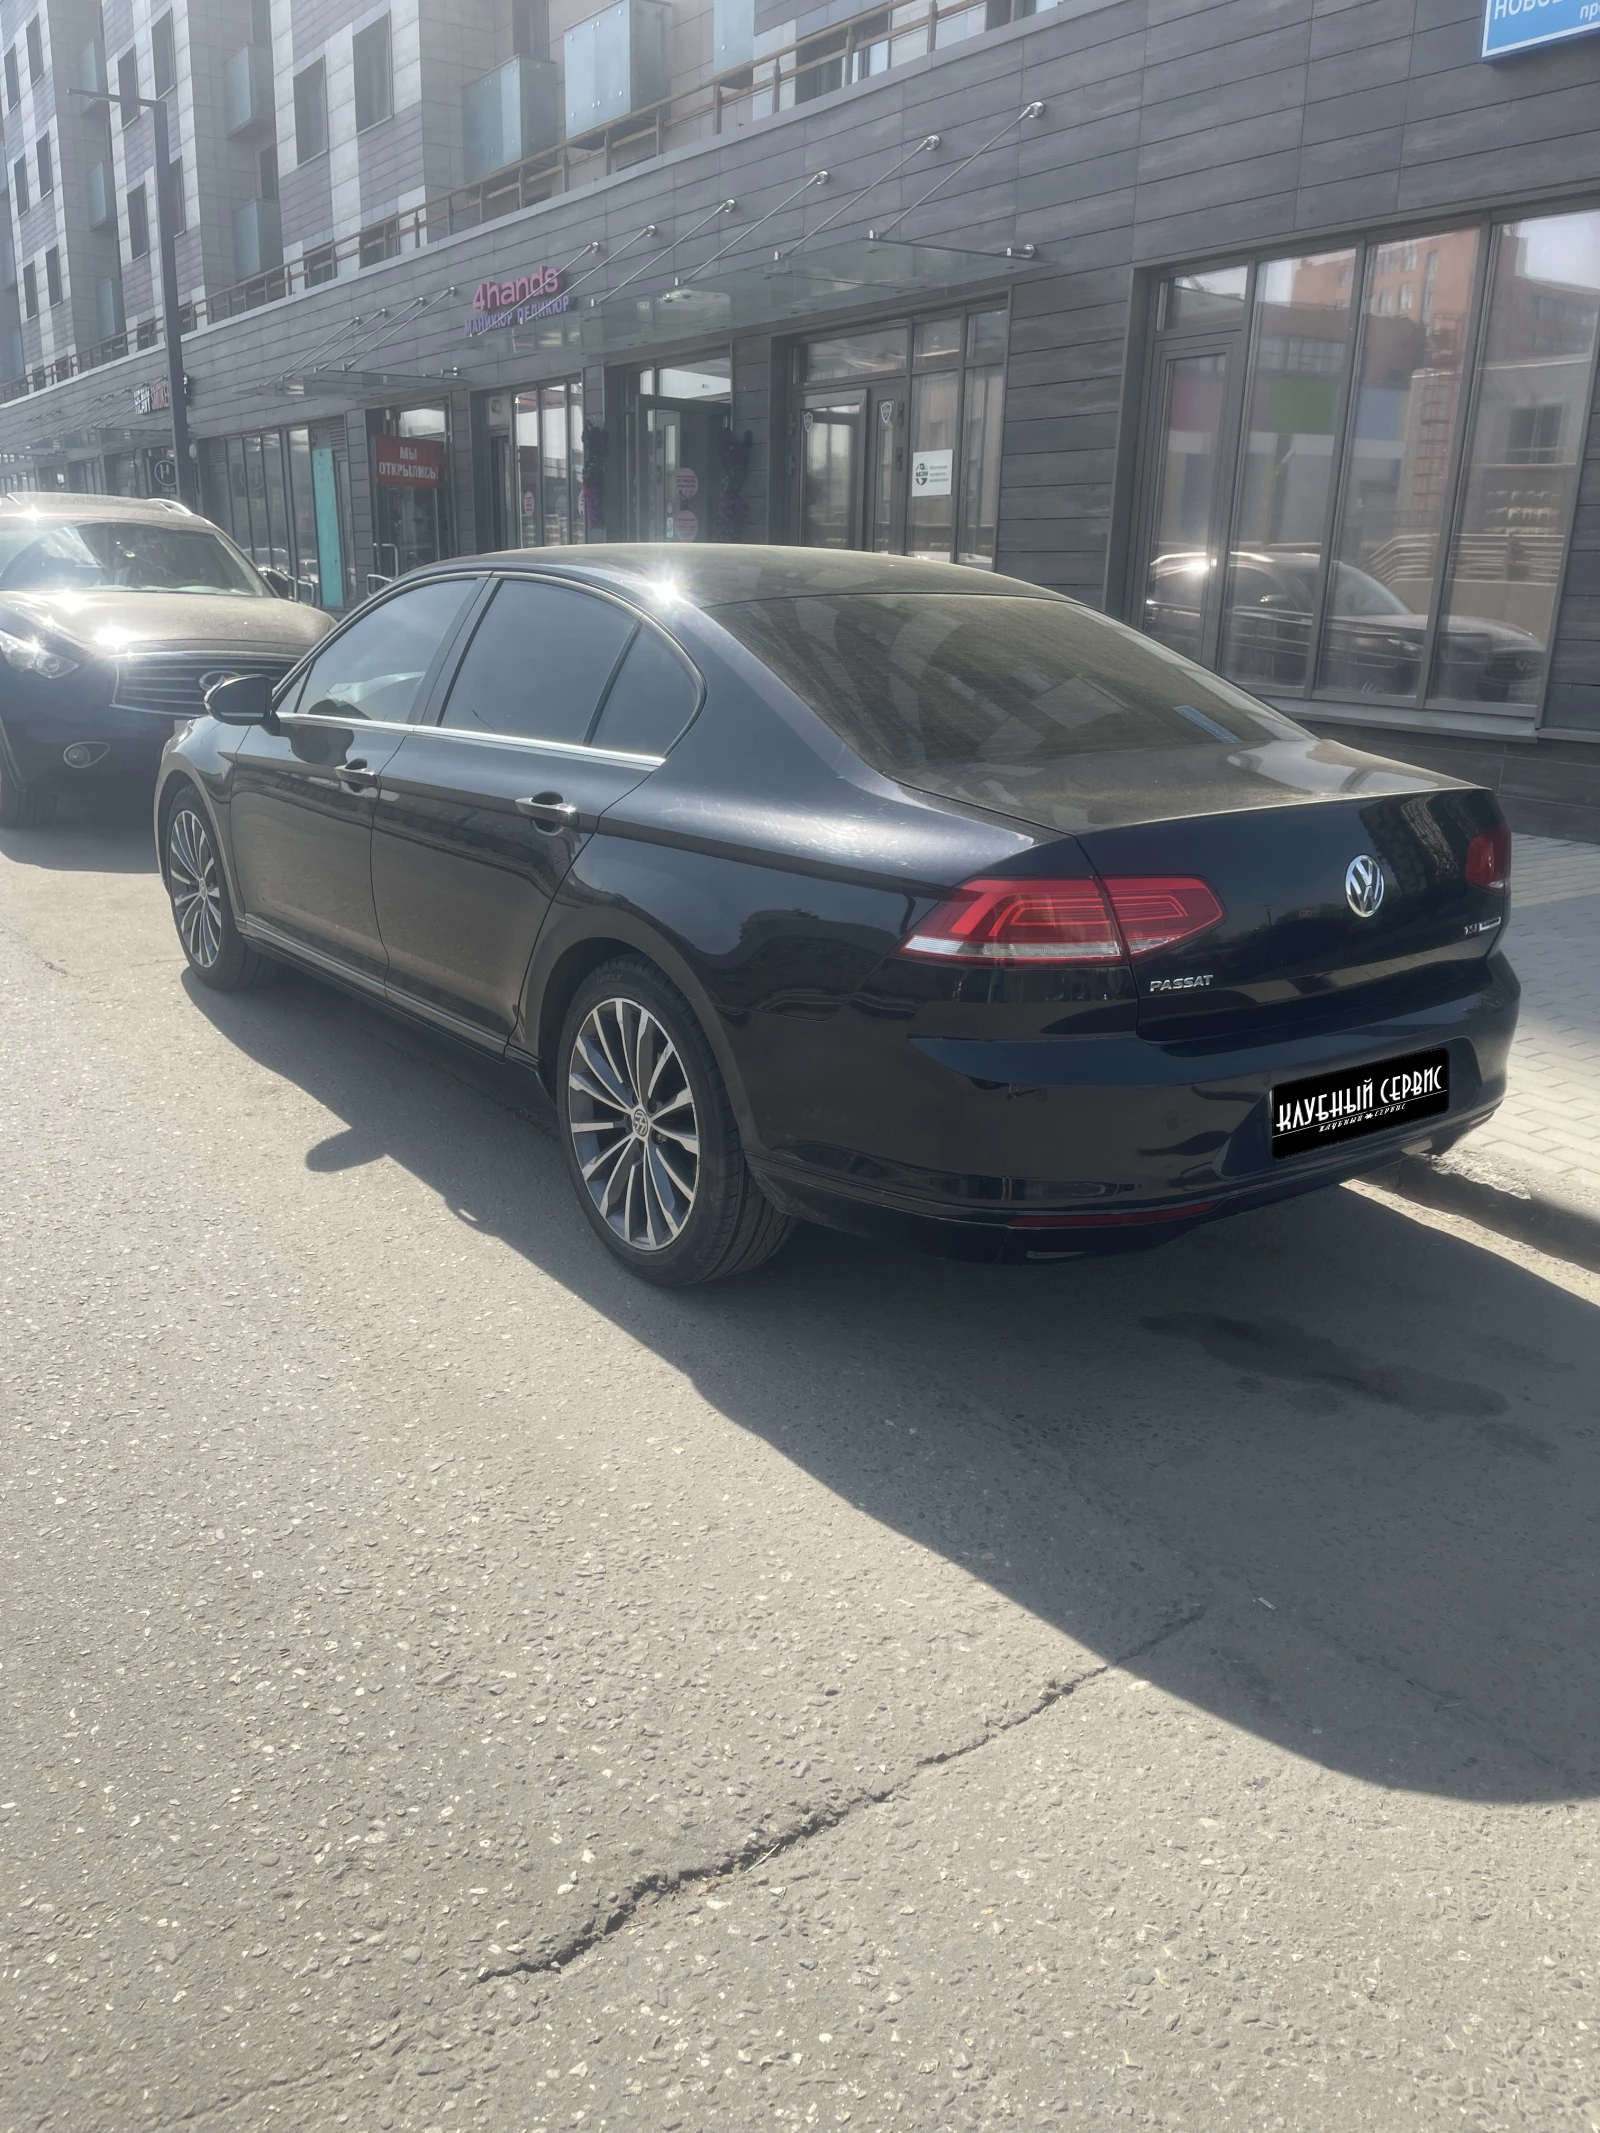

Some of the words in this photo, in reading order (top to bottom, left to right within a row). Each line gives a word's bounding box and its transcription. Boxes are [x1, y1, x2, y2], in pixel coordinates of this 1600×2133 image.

[1580, 2, 1600, 21] пр
[472, 265, 559, 311] 4hands
[464, 311, 513, 336] МАНИКЮР
[517, 295, 569, 323] ПЕДИКЮР
[400, 446, 418, 461] МЫ
[1149, 974, 1214, 992] PASSAT
